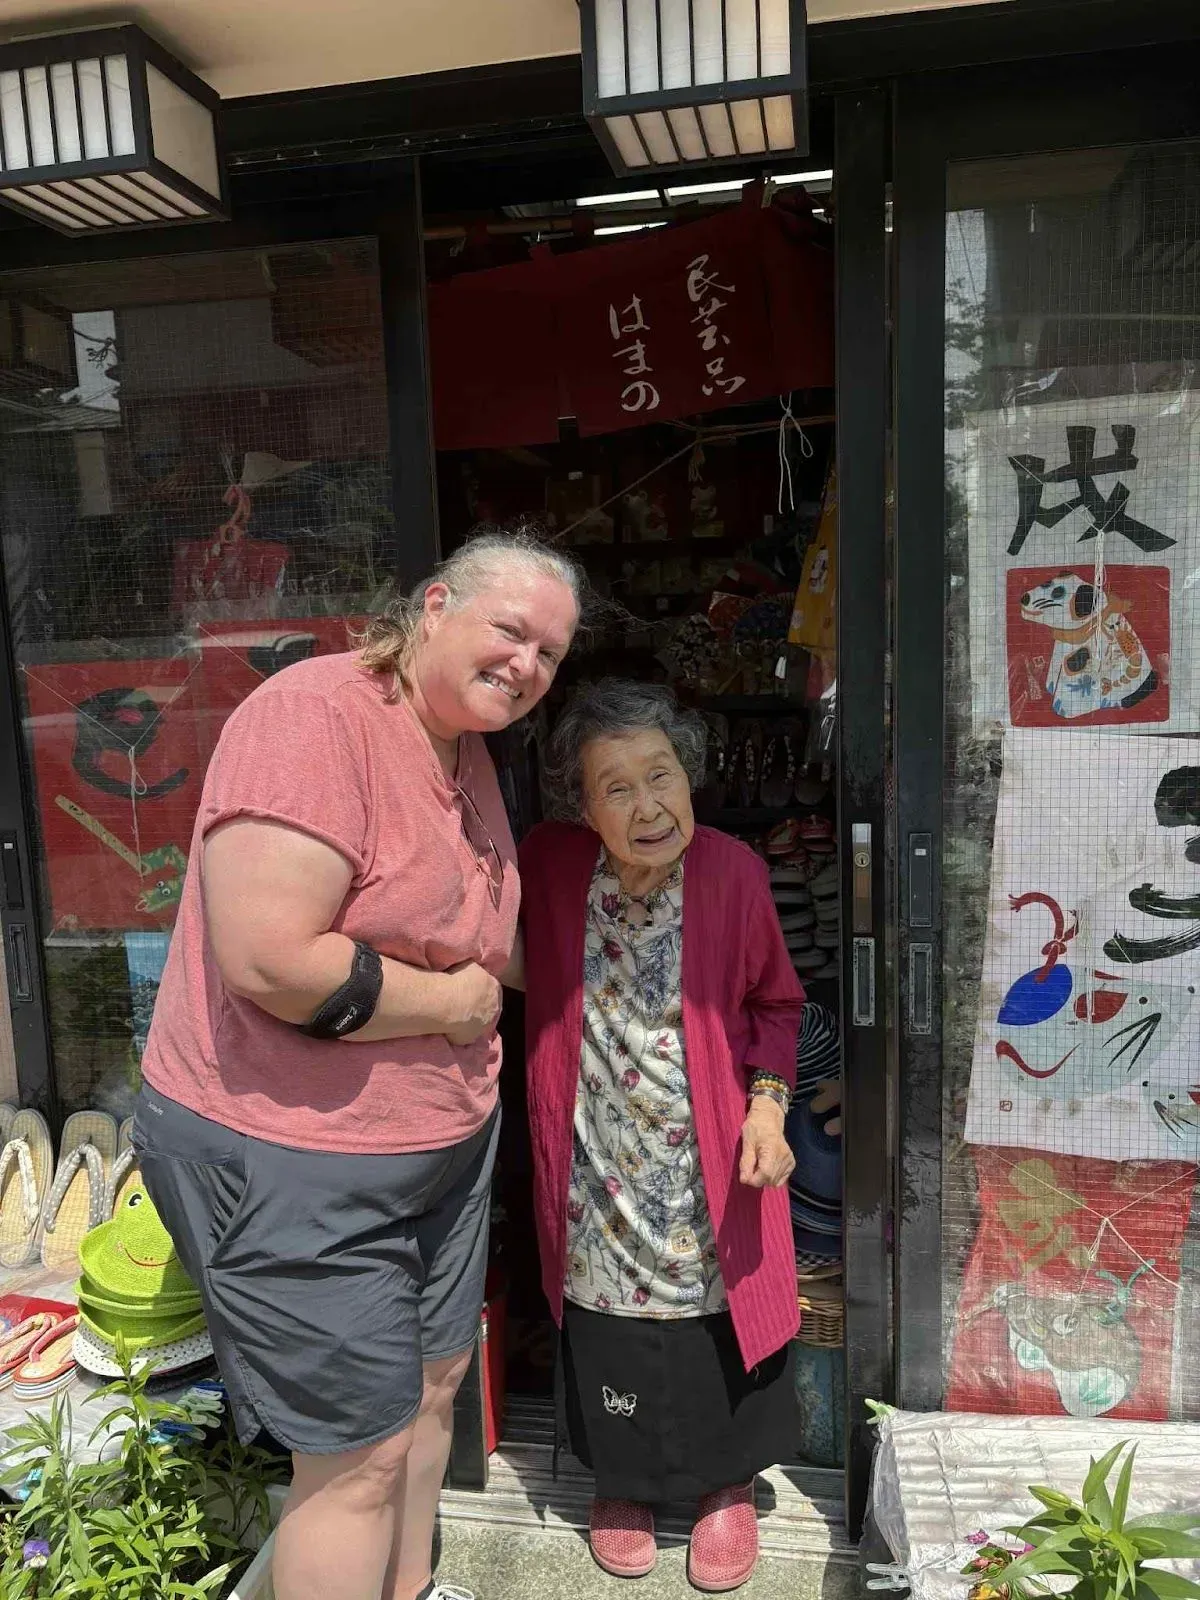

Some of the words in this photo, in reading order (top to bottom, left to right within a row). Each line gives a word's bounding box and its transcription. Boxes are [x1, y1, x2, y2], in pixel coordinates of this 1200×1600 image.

[608, 293, 661, 413] はまの
[686, 253, 746, 397] 民芸品
